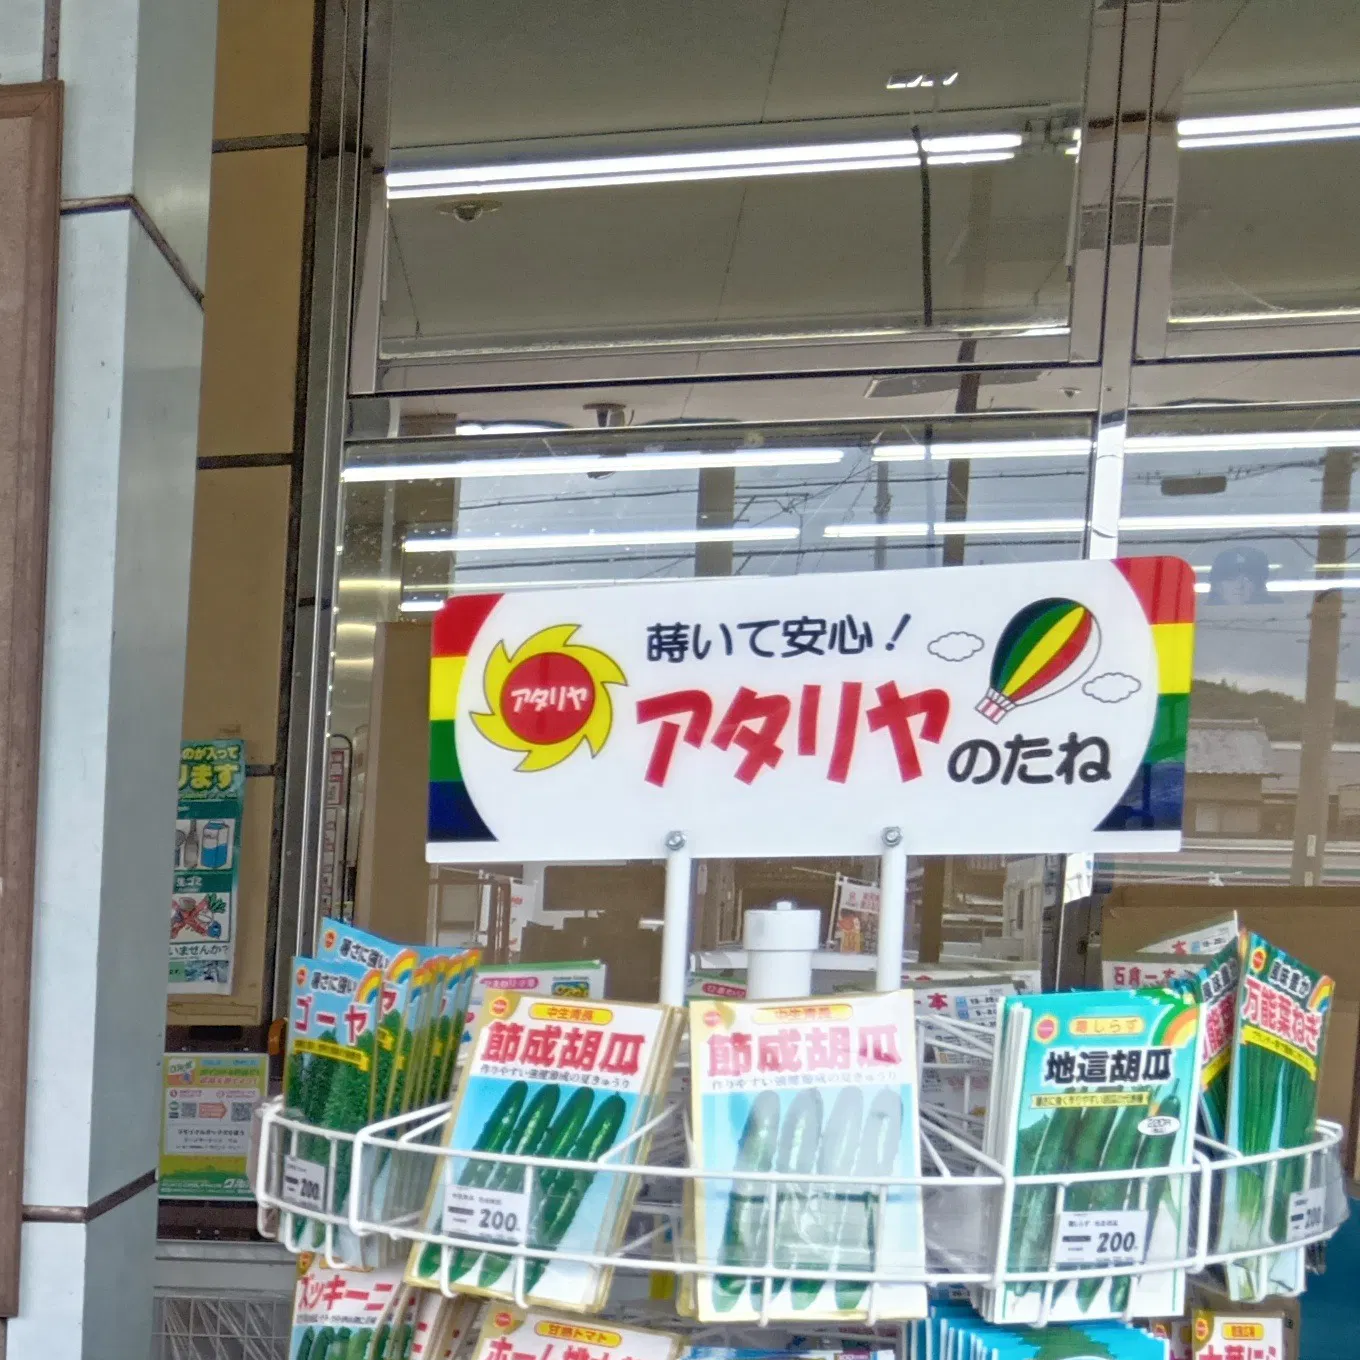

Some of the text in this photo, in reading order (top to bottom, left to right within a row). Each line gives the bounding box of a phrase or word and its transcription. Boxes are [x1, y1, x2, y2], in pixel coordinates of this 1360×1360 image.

[510, 683, 589, 713] アタリヤ
[635, 680, 1111, 788] アタリヤ のたね
[294, 995, 369, 1046] ゴーヤ
[1242, 976, 1323, 1054] 万能葉ねぎ
[481, 1021, 646, 1076] 節成胡瓜
[707, 1024, 902, 1077] 節成胡瓜
[1044, 1048, 1174, 1084] 地這胡瓜
[479, 1207, 518, 1233] 200
[1095, 1231, 1136, 1253] 200
